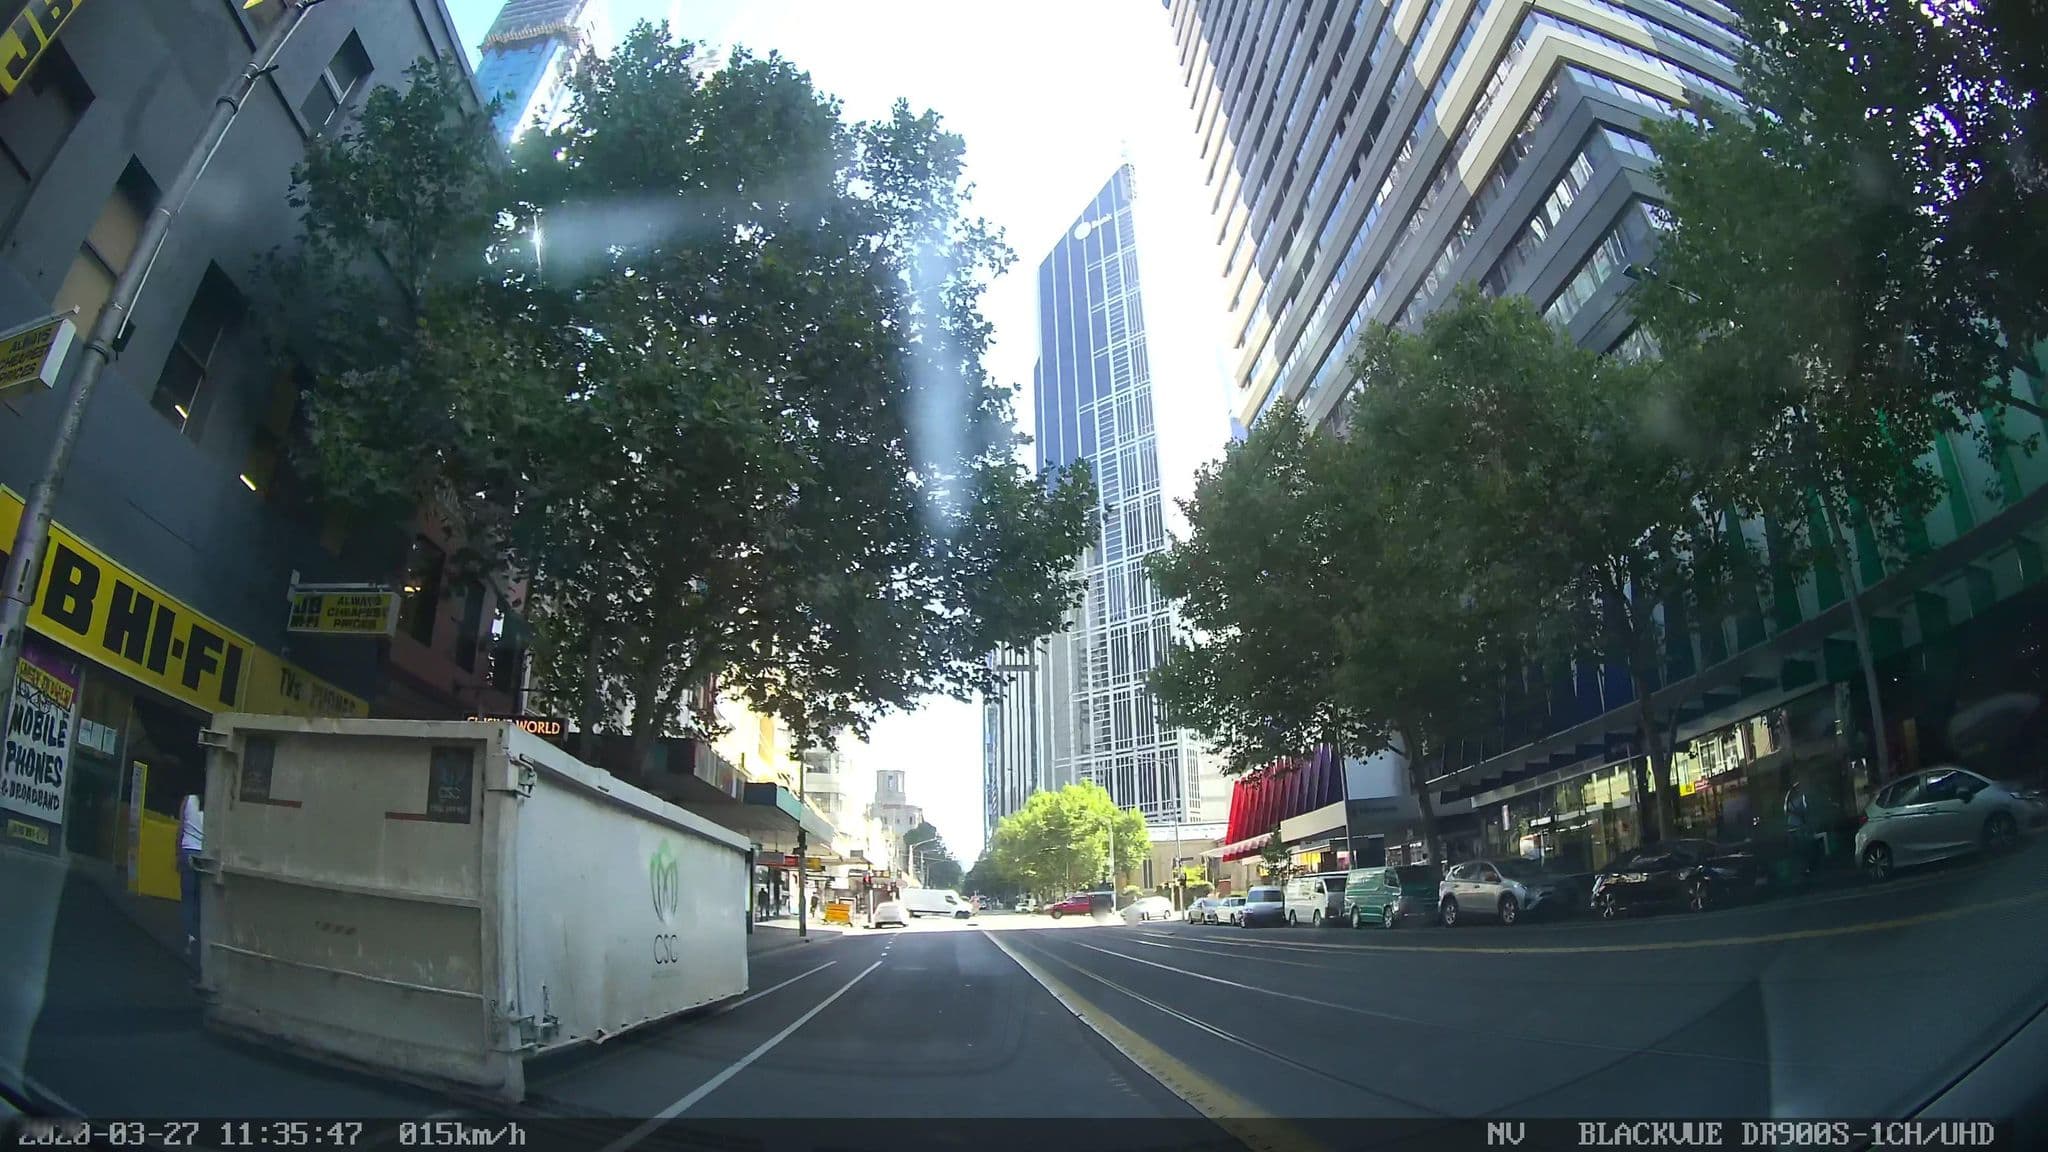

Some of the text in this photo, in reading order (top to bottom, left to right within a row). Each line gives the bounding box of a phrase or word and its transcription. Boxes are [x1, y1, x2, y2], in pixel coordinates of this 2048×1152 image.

[5, 0, 75, 80] JB
[103, 579, 243, 707] HI-FI
[8, 703, 69, 749] MOBILE
[515, 720, 560, 735] WORLD
[5, 740, 63, 788] PHONES
[9, 781, 60, 812] BROADBAND
[654, 934, 679, 965] CSC
